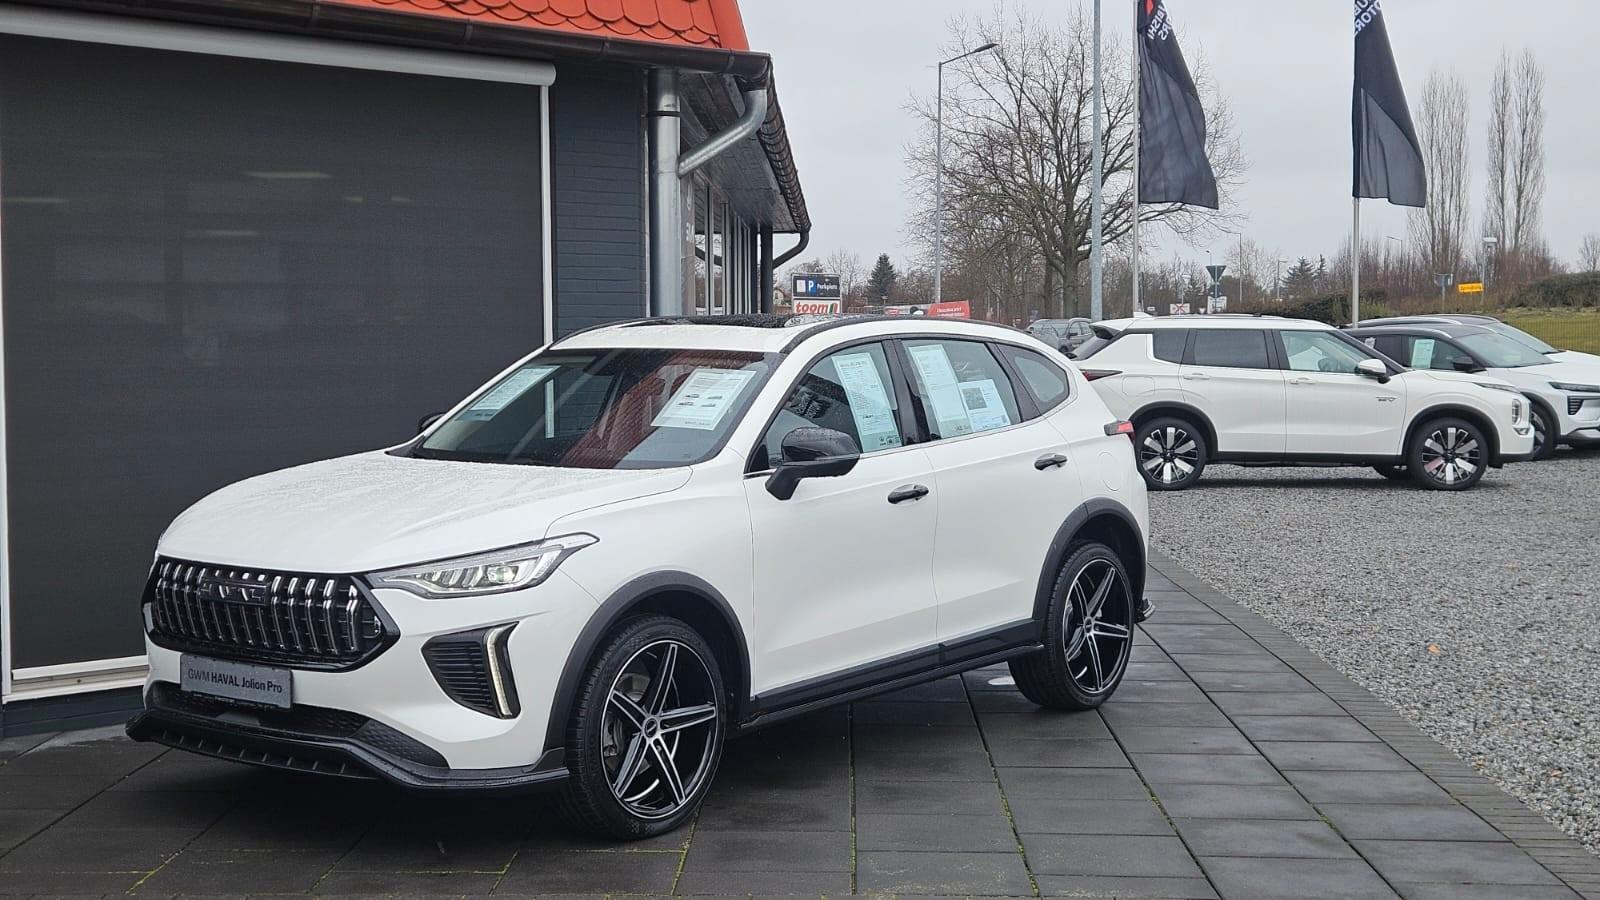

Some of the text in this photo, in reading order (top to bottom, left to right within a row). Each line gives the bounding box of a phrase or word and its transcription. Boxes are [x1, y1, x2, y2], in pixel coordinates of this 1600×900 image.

[808, 280, 815, 292] P
[796, 302, 829, 313] toom
[187, 668, 283, 693] GWM HAVAL Jolion Pro
